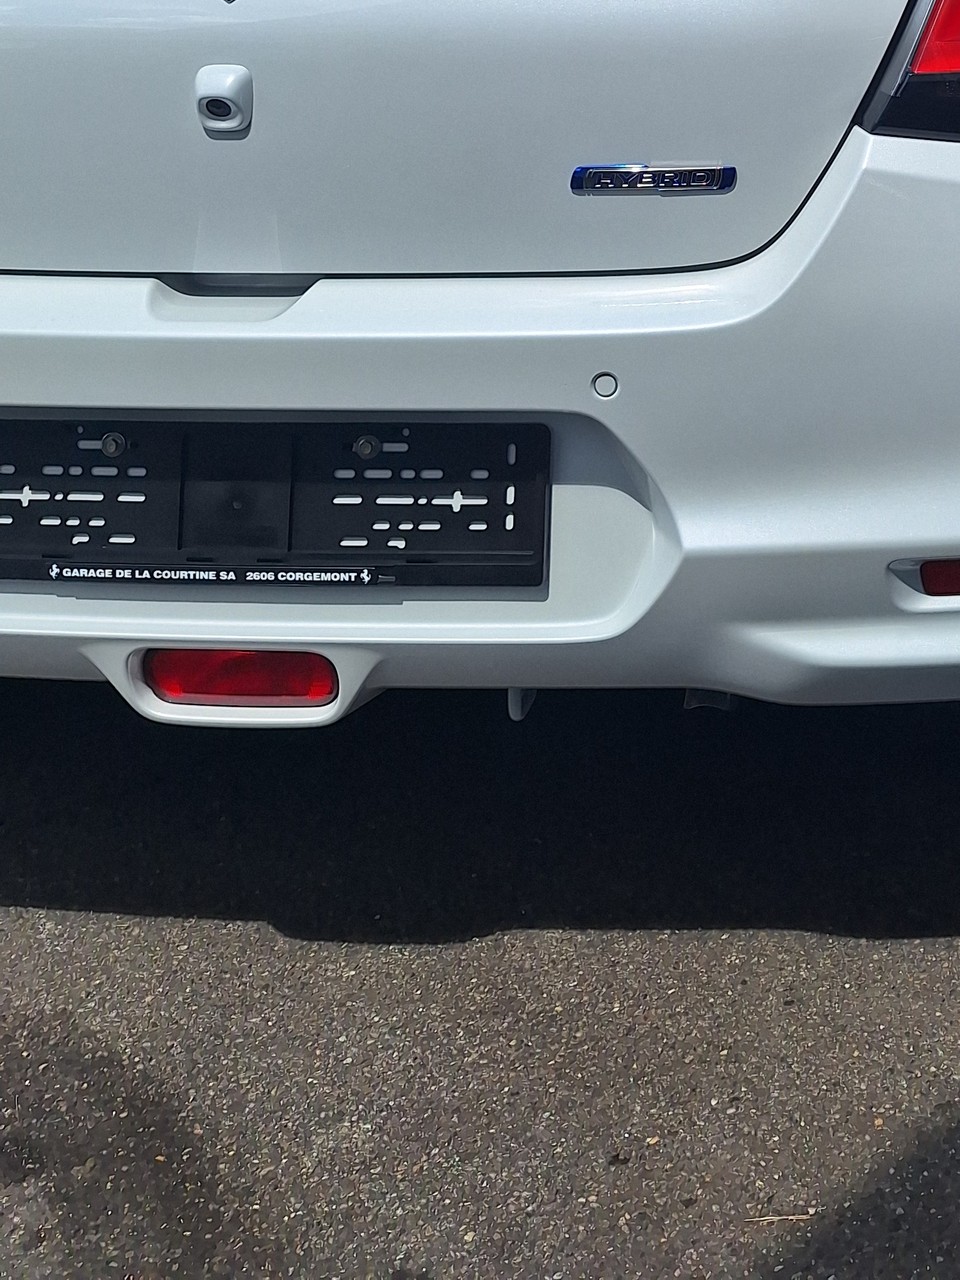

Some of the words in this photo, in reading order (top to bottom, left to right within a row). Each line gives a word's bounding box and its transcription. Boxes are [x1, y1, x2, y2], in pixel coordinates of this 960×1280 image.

[594, 172, 713, 188] HYBRID
[62, 568, 113, 578] GARAGE
[115, 569, 132, 579] DE
[135, 569, 151, 579] LA
[153, 570, 217, 580] COURTINE
[219, 571, 236, 581] SA
[245, 571, 275, 581] 2606
[277, 572, 358, 582] CORGEMONT
